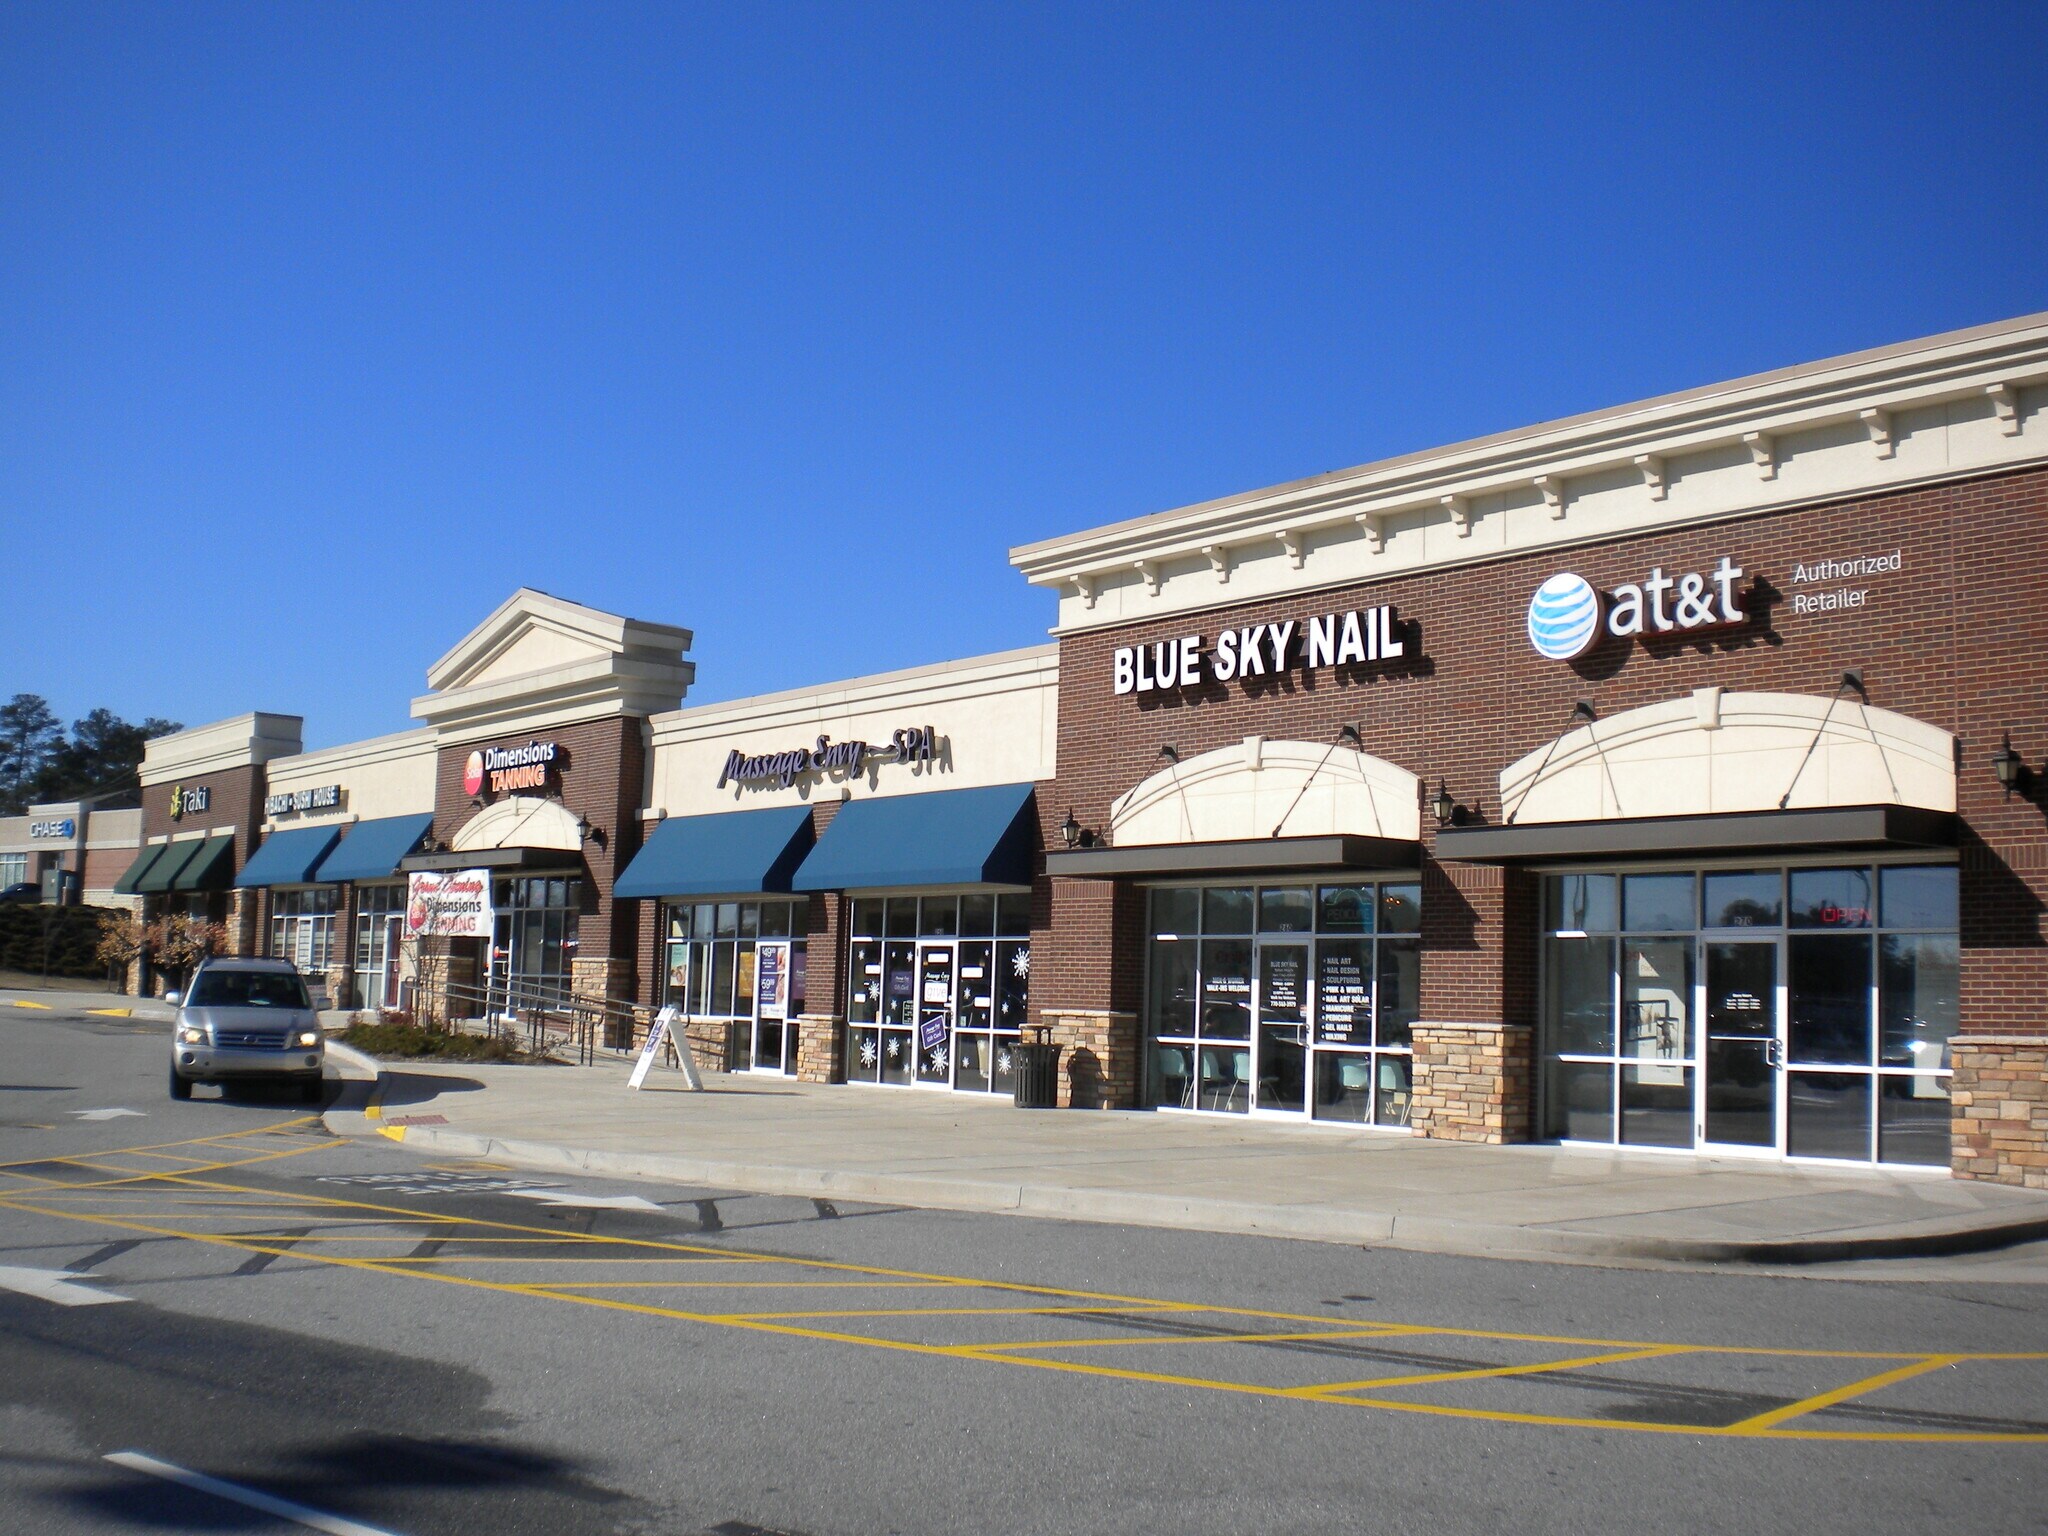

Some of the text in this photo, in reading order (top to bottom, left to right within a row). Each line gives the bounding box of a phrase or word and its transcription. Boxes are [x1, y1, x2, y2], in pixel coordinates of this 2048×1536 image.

[1793, 549, 1902, 584] Authorized
[1608, 556, 1743, 637] at&t
[1794, 587, 1869, 614] Retailer
[1114, 605, 1404, 695] BLUE SKY NAIL
[485, 740, 554, 770] Dimensions
[717, 725, 935, 789] Massage Envy SPA
[490, 763, 546, 792] TANNING
[182, 787, 206, 812] Taki
[293, 789, 312, 811] SUSHI
[313, 784, 337, 808] HOUSE
[30, 822, 64, 838] CHASE
[427, 897, 482, 913] Dimensions
[1822, 907, 1873, 922] OPEN
[429, 915, 477, 931] ANNING
[1340, 957, 1351, 965] ART
[1326, 976, 1361, 984] SCULPTURED
[926, 987, 947, 1000] give
